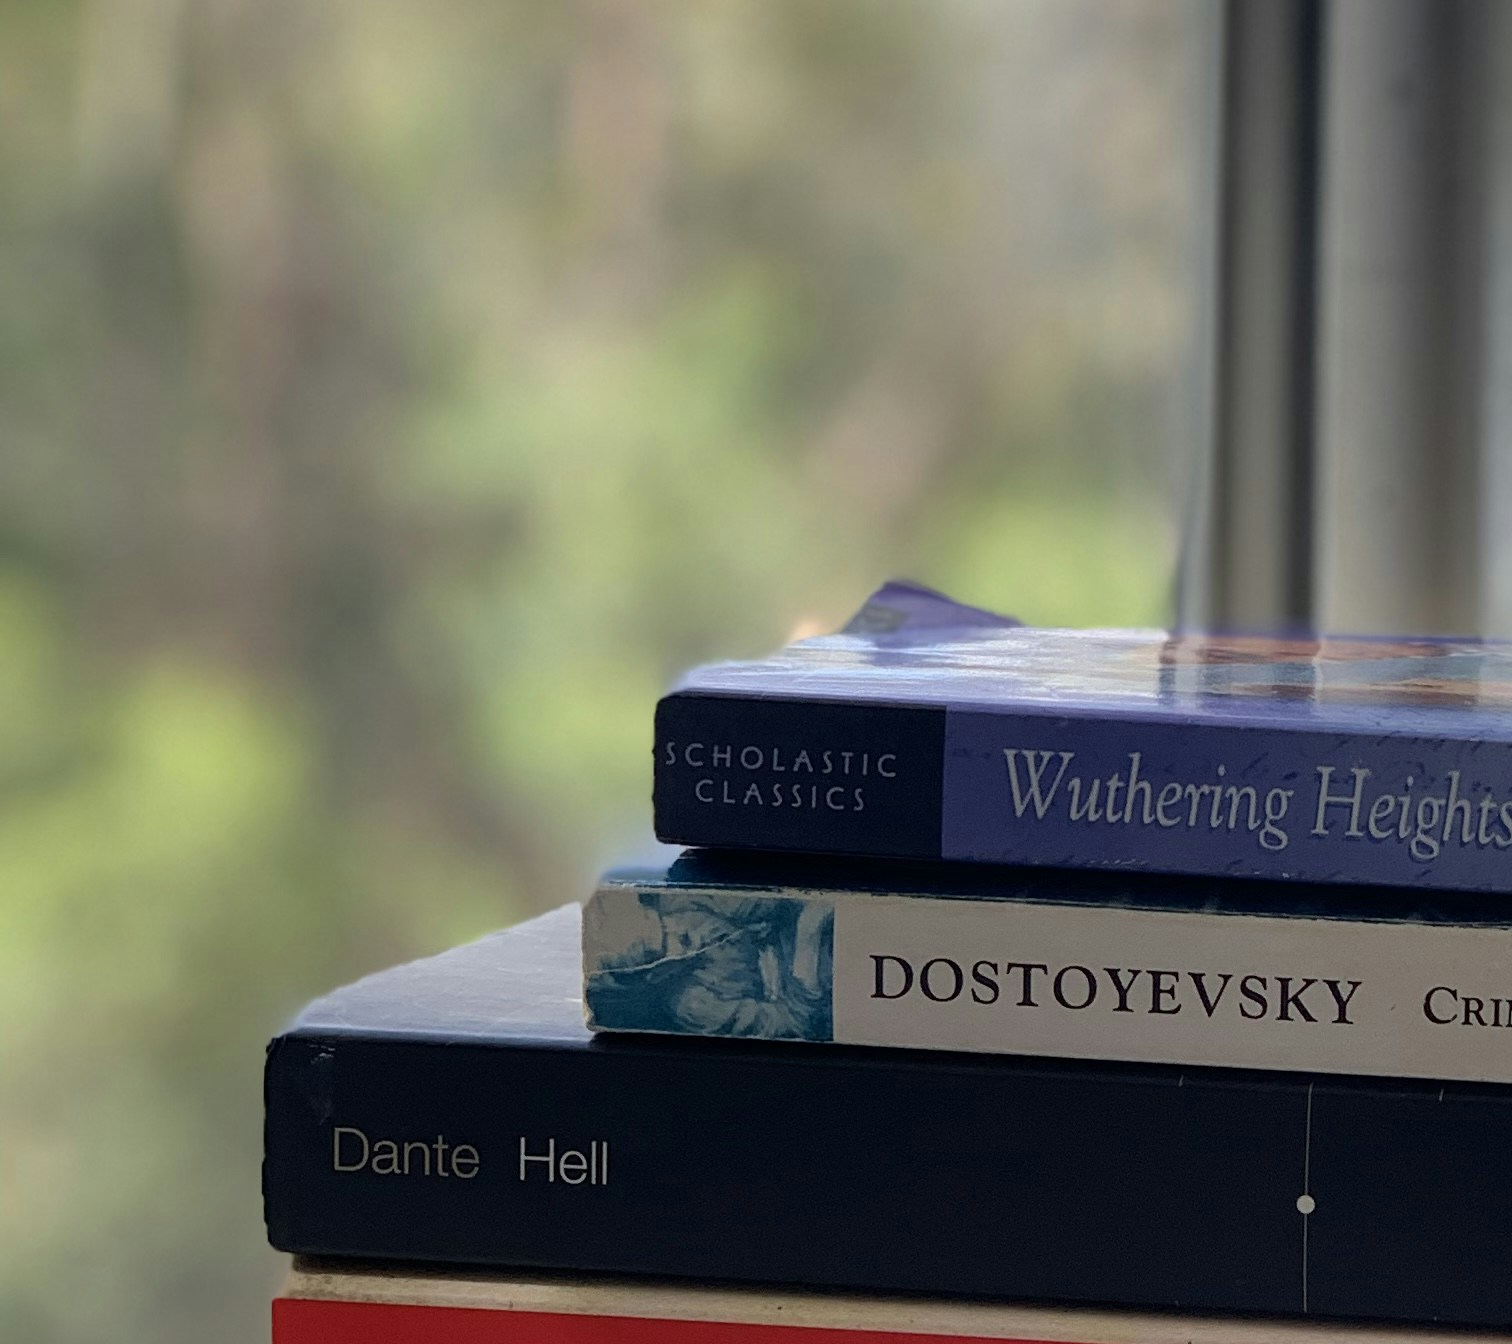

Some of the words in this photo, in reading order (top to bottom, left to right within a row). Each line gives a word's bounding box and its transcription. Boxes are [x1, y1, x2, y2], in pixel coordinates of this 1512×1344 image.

[664, 740, 898, 779] SCHOLASTIC
[695, 779, 864, 811] CLASSICS
[1003, 748, 1295, 851] Wuthering
[869, 954, 1363, 1025] DOSTOYEVSKY
[333, 1127, 480, 1179] Dante
[519, 1136, 608, 1186] Hell
